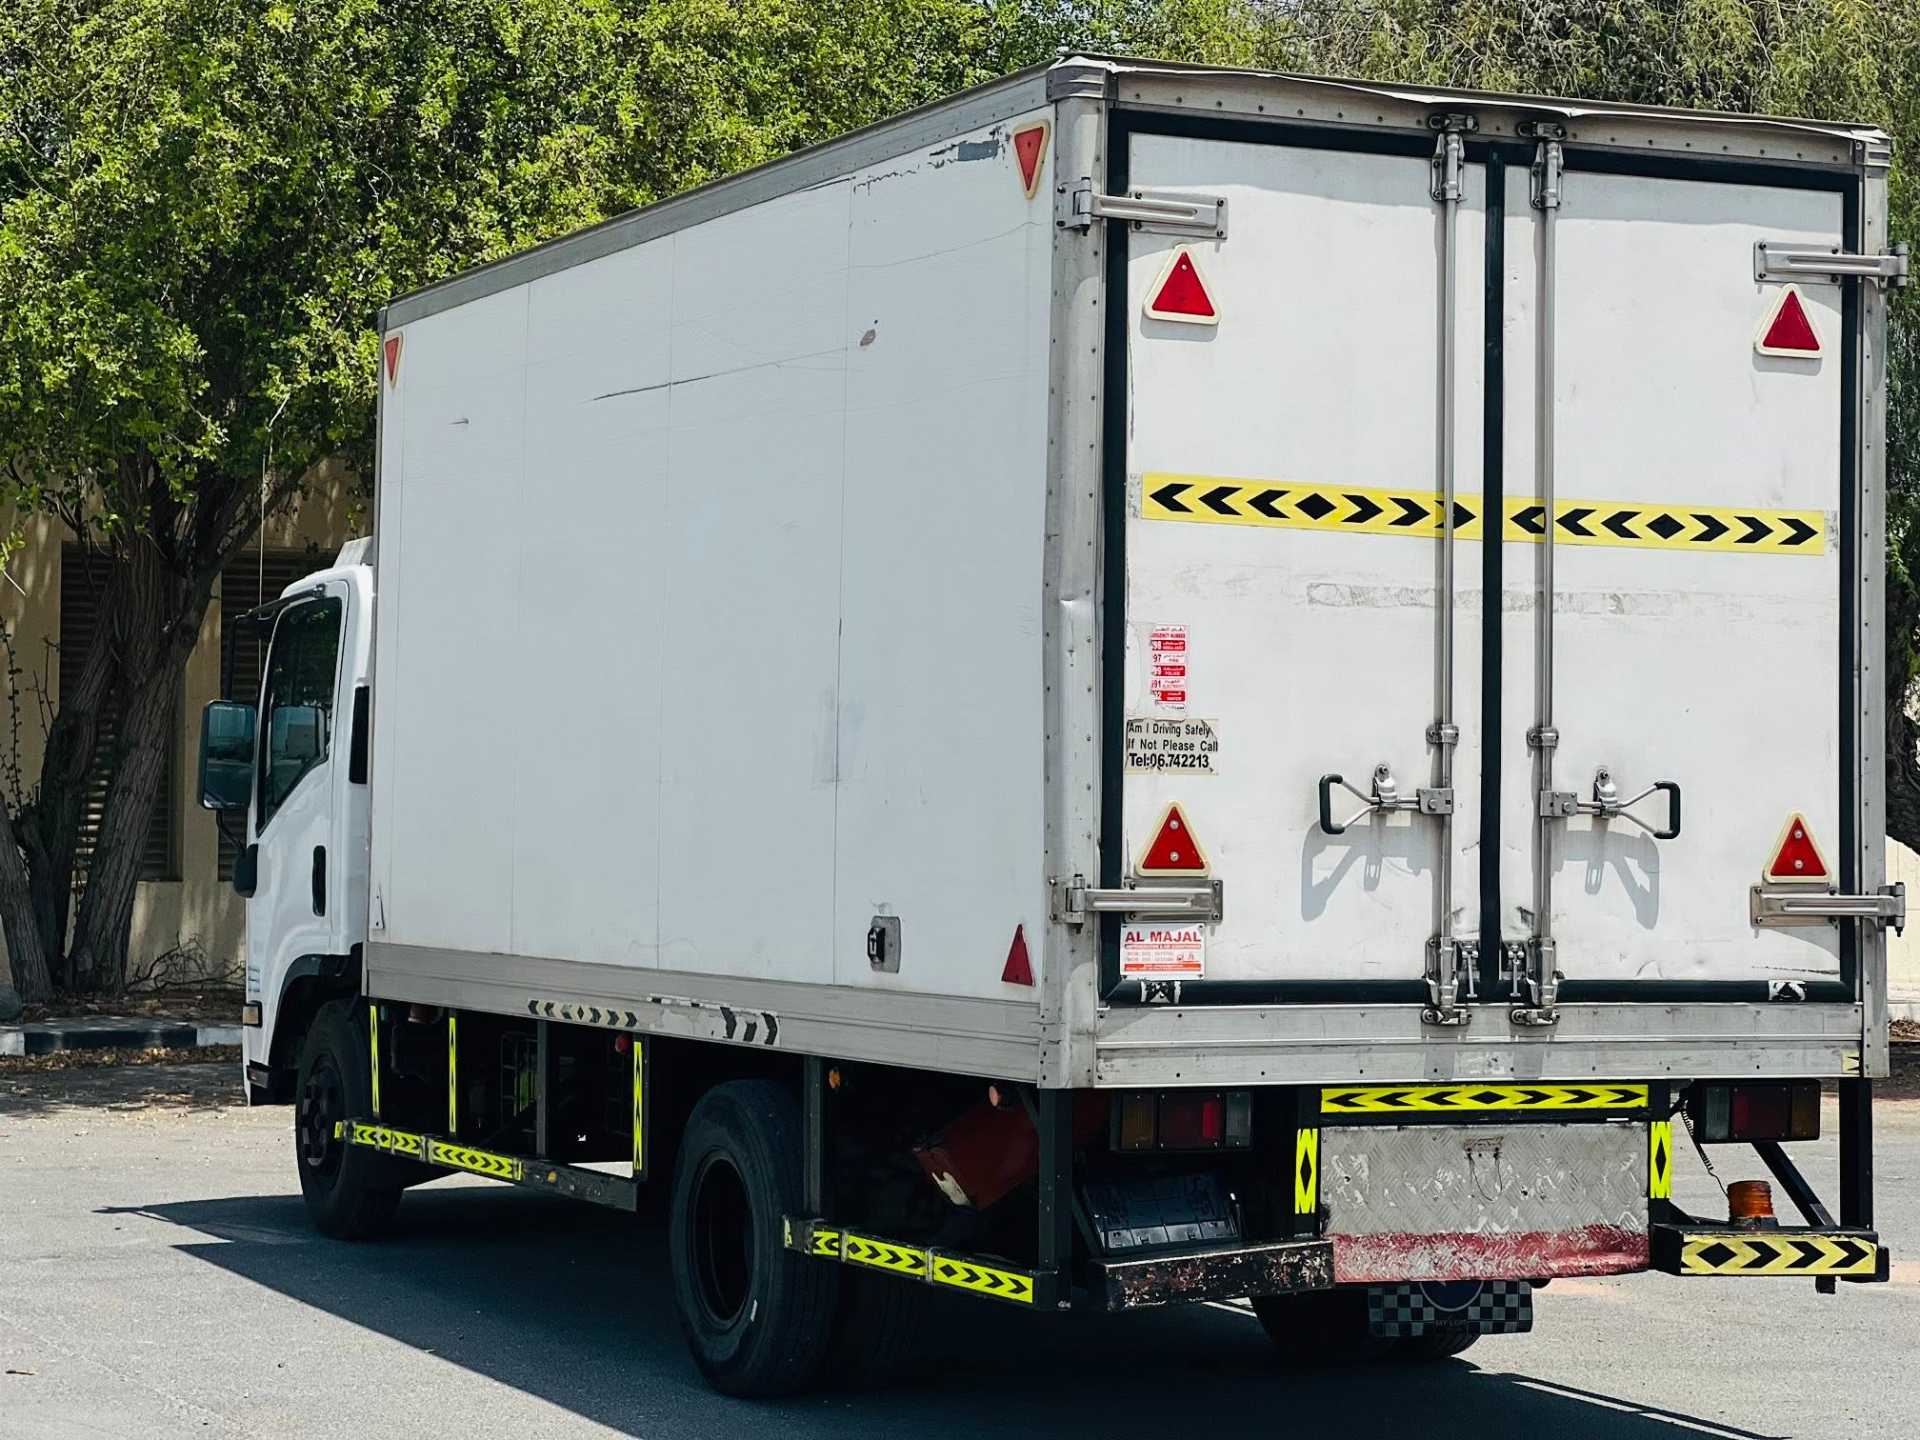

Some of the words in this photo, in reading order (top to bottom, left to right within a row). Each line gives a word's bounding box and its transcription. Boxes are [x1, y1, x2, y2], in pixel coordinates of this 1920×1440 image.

[1128, 722, 1143, 733] Am
[1146, 723, 1150, 734] I
[1152, 723, 1181, 738] Driving
[1185, 724, 1212, 739] Safely
[1128, 738, 1135, 749] If
[1140, 739, 1157, 750] Not
[1163, 740, 1195, 751] Please
[1200, 741, 1219, 752] Call
[1129, 753, 1209, 769] Tel:06.742213
[1125, 931, 1145, 942] AL
[1150, 931, 1202, 942] MAJAL
